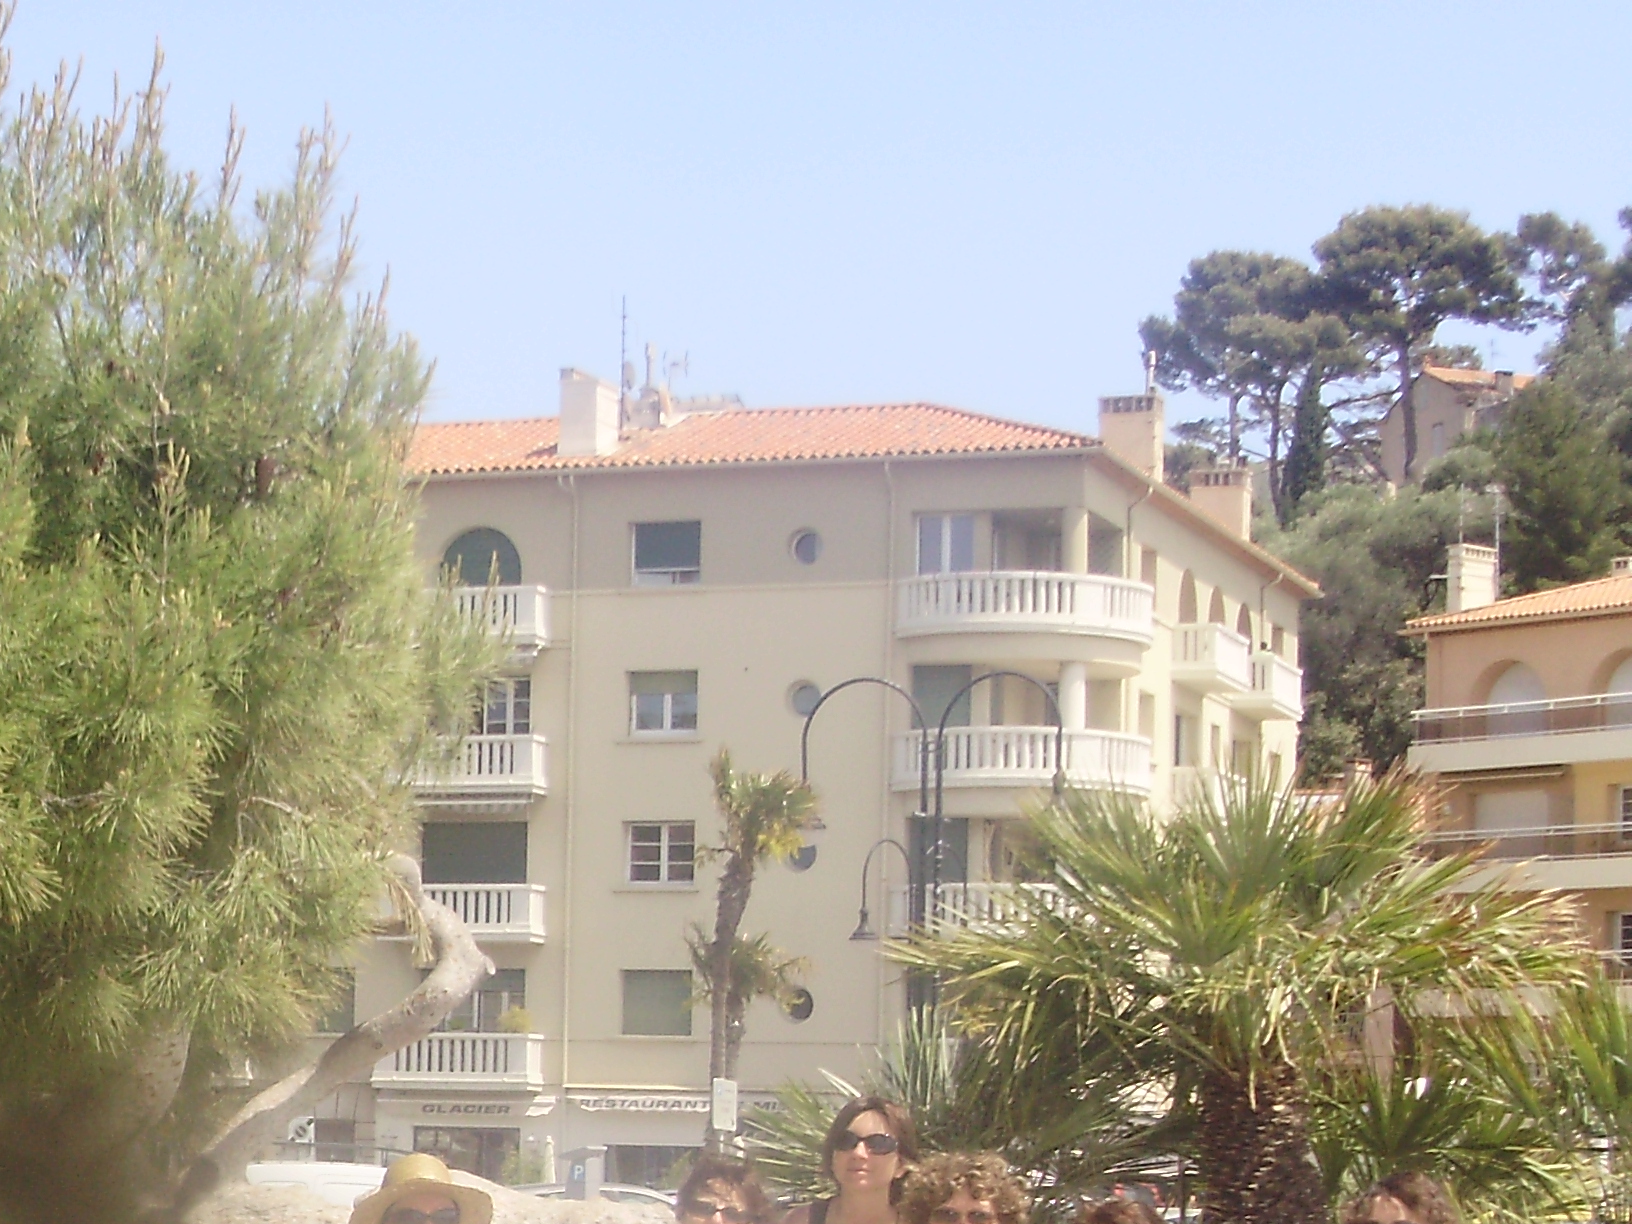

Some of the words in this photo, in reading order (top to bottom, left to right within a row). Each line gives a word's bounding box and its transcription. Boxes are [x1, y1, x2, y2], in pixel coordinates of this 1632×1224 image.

[421, 1104, 510, 1114] GLACIER
[579, 1098, 710, 1109] RESTAURANT
[574, 1165, 583, 1180] P
